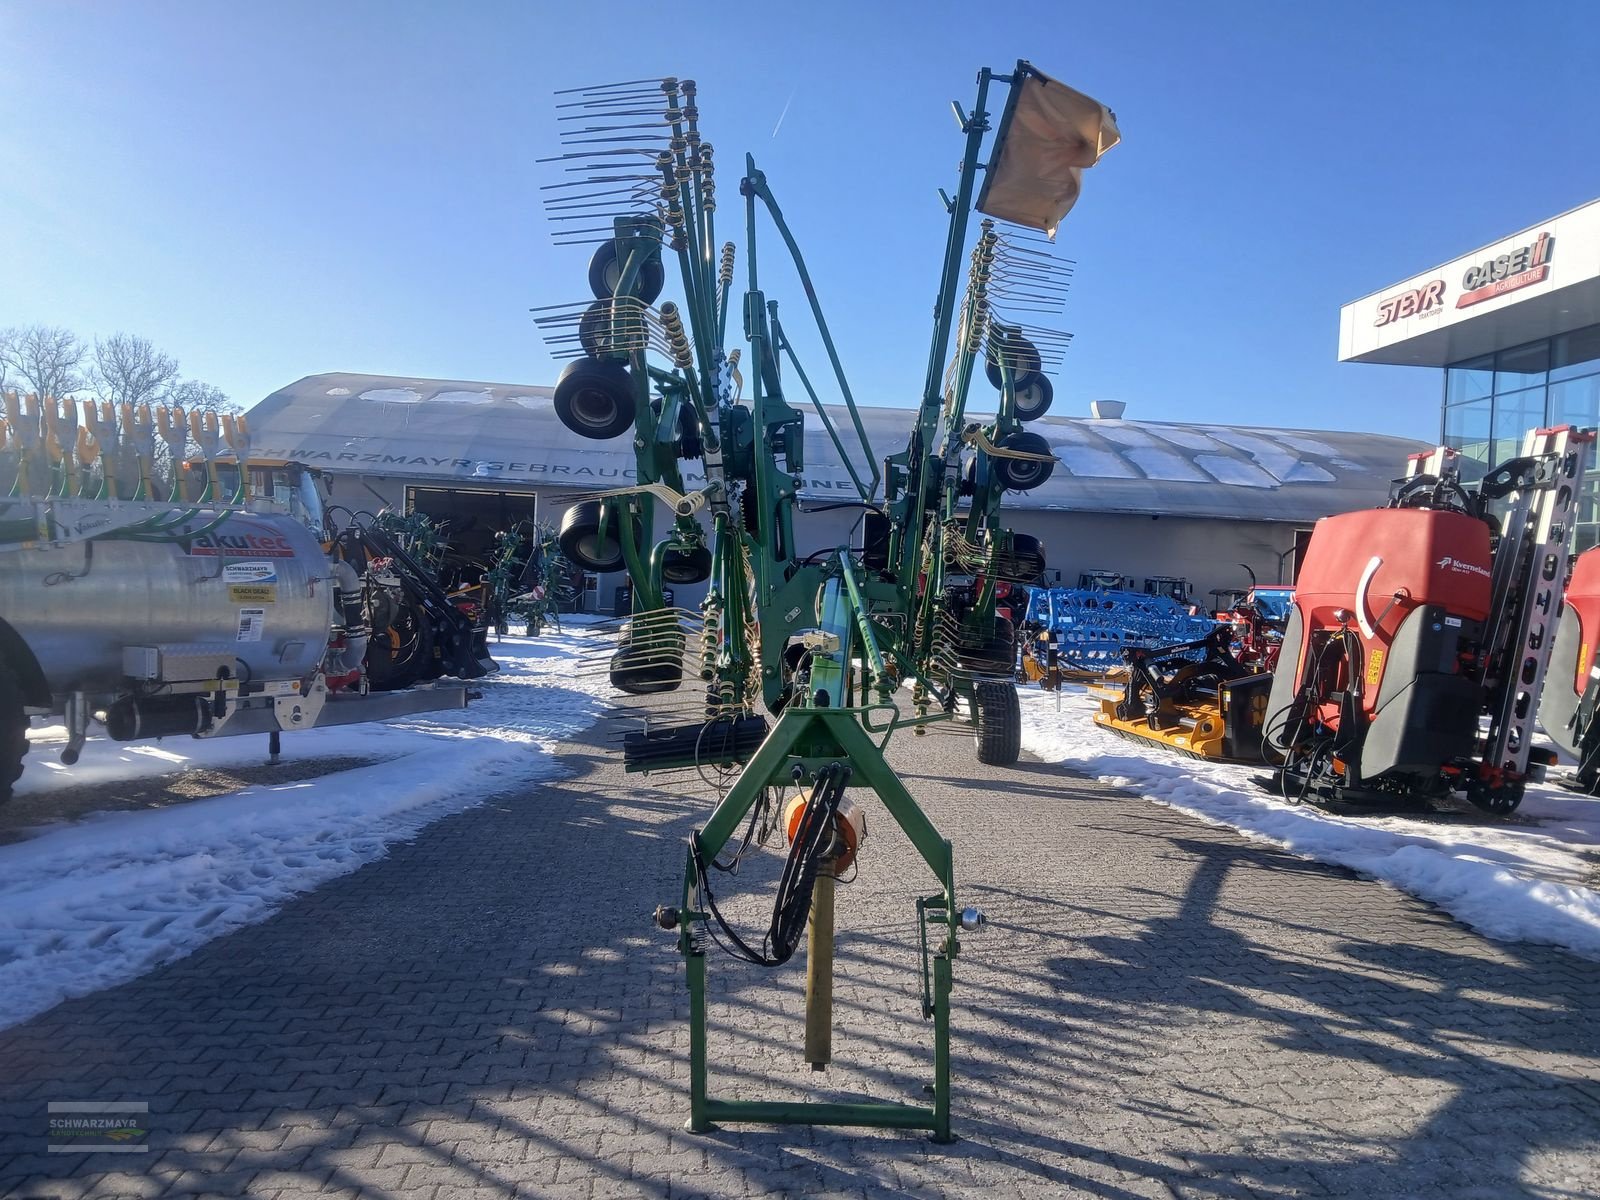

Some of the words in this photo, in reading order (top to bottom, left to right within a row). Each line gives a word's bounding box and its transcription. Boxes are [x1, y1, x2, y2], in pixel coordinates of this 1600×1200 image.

[1463, 247, 1529, 290] CASE
[1495, 269, 1542, 293] AGRICULTURE
[1374, 279, 1446, 327] STEYR
[243, 448, 472, 468] CHWARZMAYR
[1452, 559, 1491, 578] Kverneland
